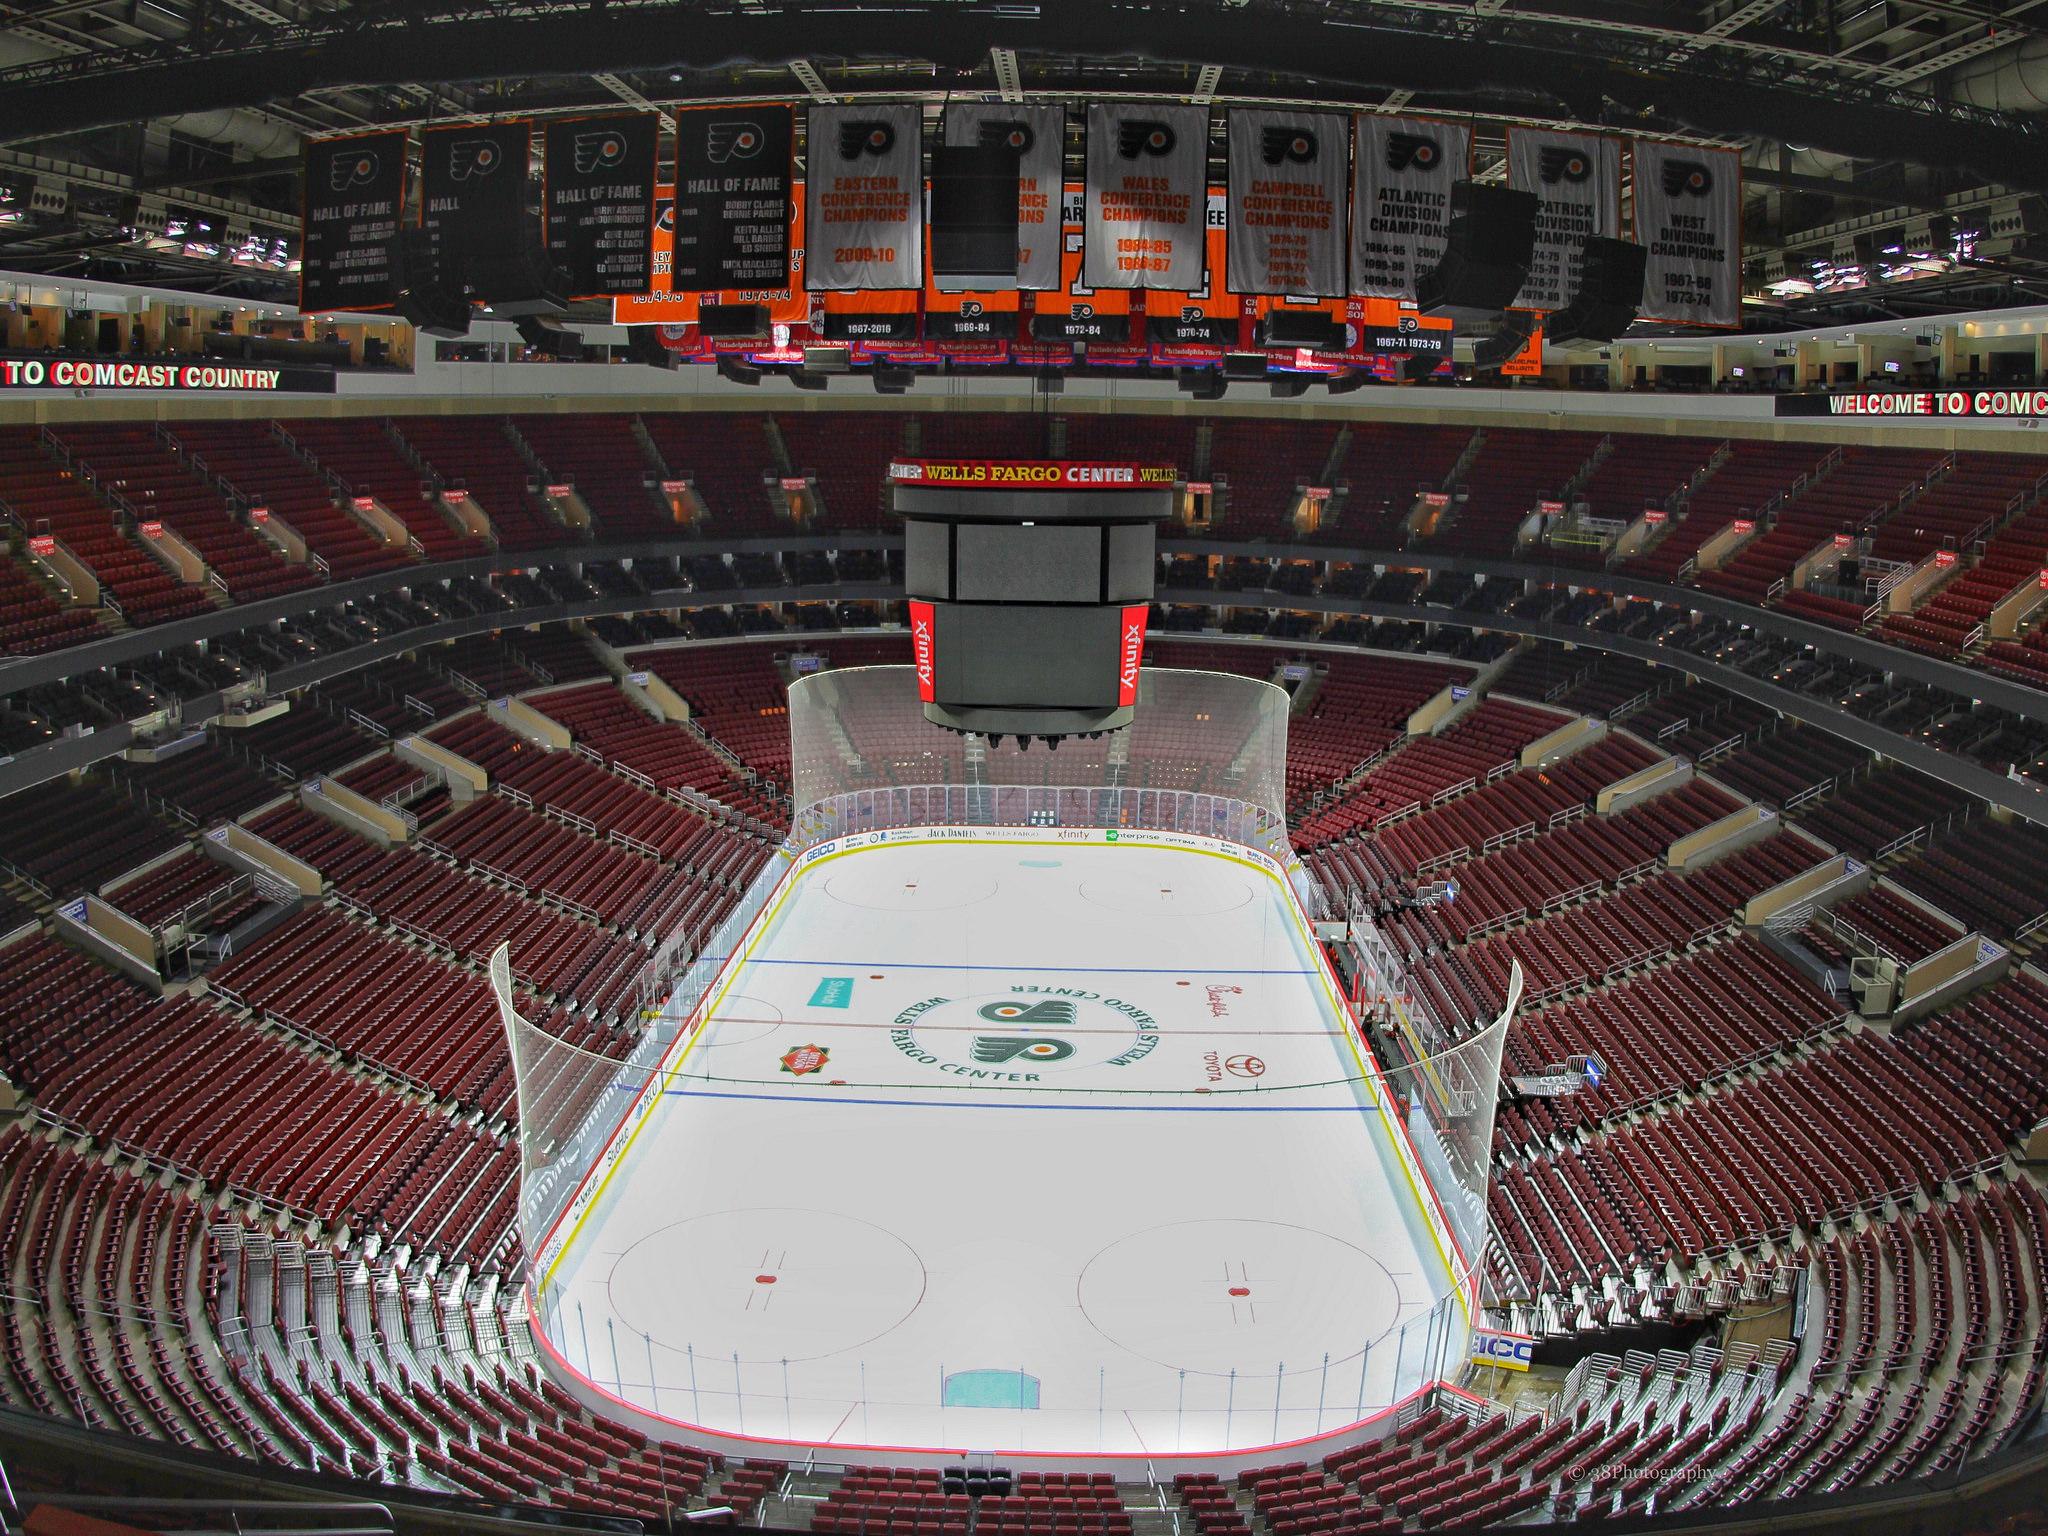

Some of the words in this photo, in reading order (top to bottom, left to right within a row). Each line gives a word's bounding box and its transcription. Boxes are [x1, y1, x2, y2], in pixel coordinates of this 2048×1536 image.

[688, 179, 720, 193] HALL
[724, 178, 741, 192] OF
[744, 177, 781, 191] FAME
[834, 176, 898, 191] EASTERN
[1123, 177, 1169, 192] WALES
[1252, 180, 1325, 197] CAMPBELL
[556, 189, 587, 204] HALL
[590, 187, 604, 200] OF
[608, 185, 642, 199] FAME
[820, 192, 910, 207] CONFERENCE
[1100, 192, 1190, 208] CONFERENCE
[1378, 188, 1446, 207] ATLANTIC
[313, 207, 341, 221] HALL
[343, 205, 358, 218] OF
[360, 201, 392, 216] FAME
[430, 197, 459, 213] HALL
[1243, 196, 1333, 214] CONFERENCE
[1381, 204, 1442, 222] DIVISION
[1536, 200, 1594, 217] PATRICK
[823, 207, 907, 223] CHAMPIONS
[1102, 207, 1186, 224] CHAMPIONS
[1245, 211, 1330, 230] CHAMPIONS
[1535, 215, 1593, 233] DIVISION
[1670, 214, 1706, 230] WEST
[1369, 218, 1449, 239] CHAMPIONS
[1660, 228, 1715, 246] DIVISION
[1117, 239, 1172, 253] 1984-85
[1534, 231, 1585, 247] HAMPIO
[834, 248, 895, 263] 2009-10
[1651, 242, 1725, 262] CHAMPIONS
[363, 273, 389, 283] WATSO
[1665, 290, 1711, 307] 1973-74
[7, 361, 45, 385] TO
[55, 361, 179, 387] COMCAST
[185, 366, 281, 389] COUNTRY
[1829, 393, 1928, 414] WELCOME
[1935, 392, 1965, 414] TO
[926, 465, 986, 481] WELLS
[990, 466, 1062, 482] FARGO
[1066, 467, 1134, 482] CENTER
[1140, 468, 1175, 482] WELLS
[915, 620, 933, 686] xfinity
[1120, 624, 1140, 689] xfinity
[927, 828, 946, 838] JACK
[1057, 829, 1090, 839] xfinity
[1165, 837, 1196, 845] OPTIMA
[807, 842, 836, 861] GEICO
[1011, 985, 1100, 999] CENTER
[894, 996, 951, 1025] WELLS
[1104, 998, 1159, 1030] FARGO
[890, 1029, 937, 1065] FARGO
[1107, 1034, 1160, 1067] WELLS
[940, 1063, 1040, 1081] CENTER
[1203, 1050, 1222, 1082] TOYOTA
[643, 1079, 658, 1111] PECO
